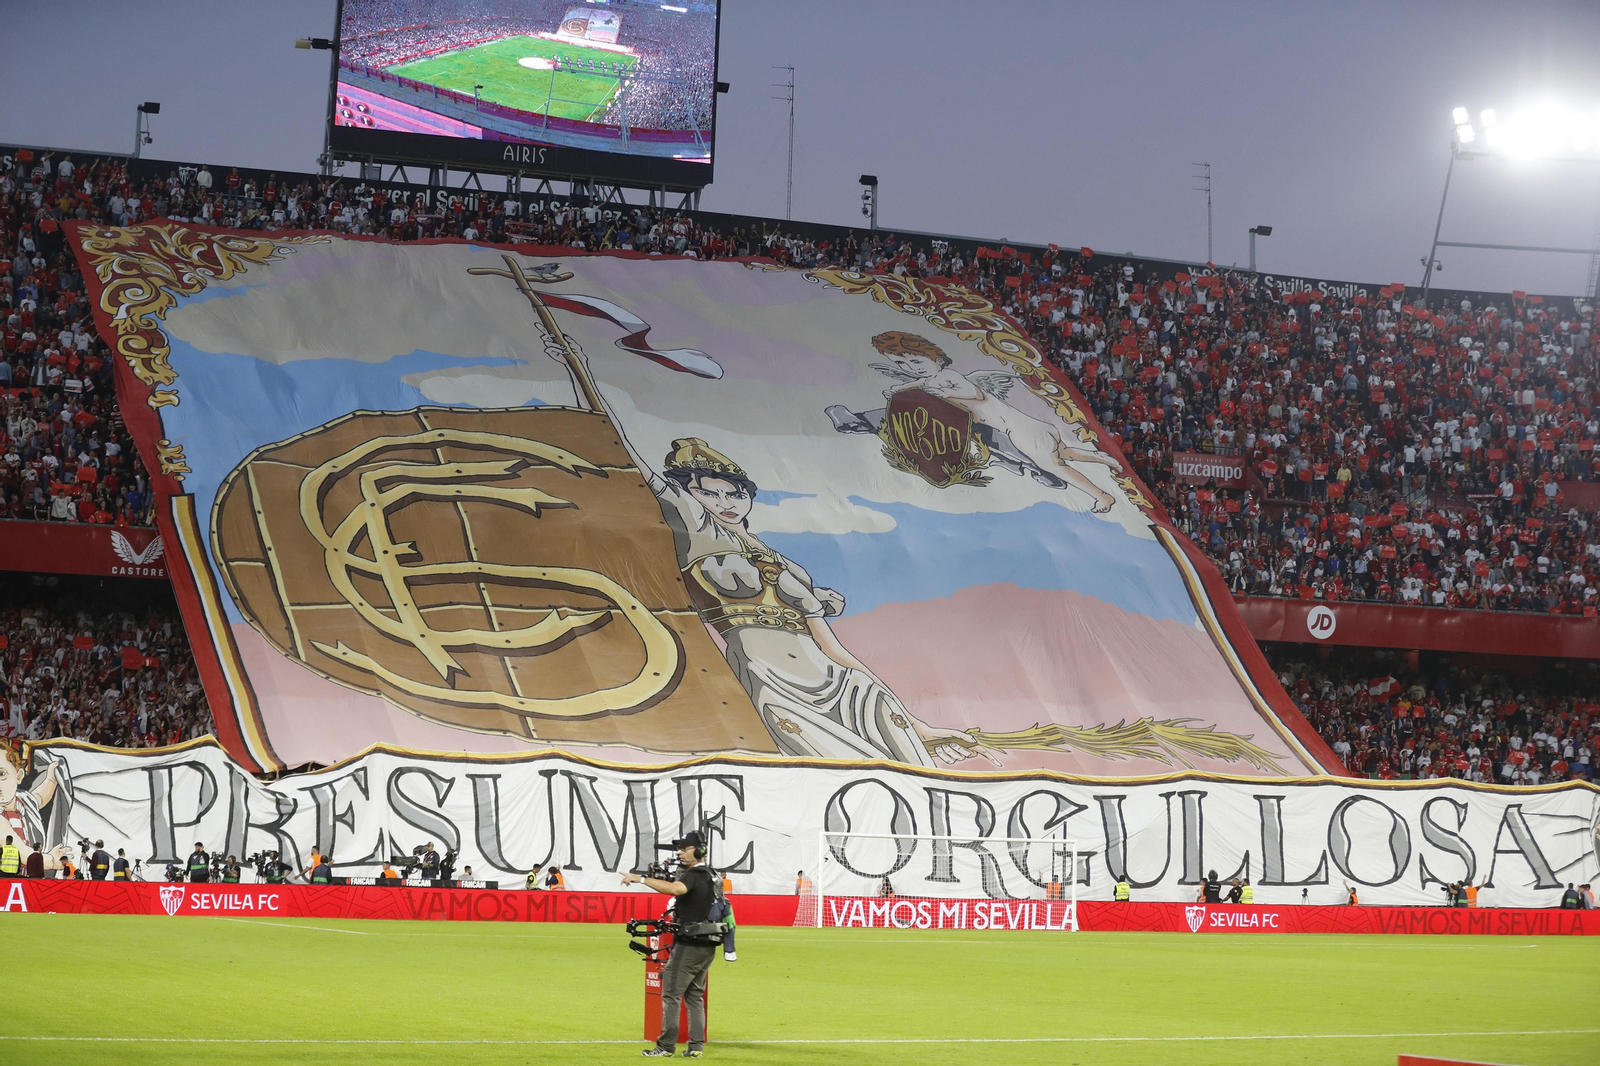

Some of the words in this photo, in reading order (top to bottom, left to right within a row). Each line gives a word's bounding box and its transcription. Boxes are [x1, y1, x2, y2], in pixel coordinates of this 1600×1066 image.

[503, 144, 547, 164] AIRIS
[1172, 462, 1243, 482] ruzcampo
[111, 566, 164, 577] CASTORE
[1310, 613, 1333, 631] JD
[141, 760, 755, 884] PRESUME
[824, 778, 1565, 900] ORGULLOSA
[190, 893, 254, 910] SEVILLA
[258, 894, 280, 911] FC
[406, 891, 518, 921] VAMOS
[526, 894, 558, 922] MI
[829, 899, 932, 928] VAMOS
[938, 902, 967, 929] MI
[974, 902, 1079, 931] SEVILLA
[1209, 912, 1259, 927] SEVILLA
[1262, 913, 1279, 928] FC
[1377, 909, 1462, 935] VAMOS
[1467, 911, 1491, 935] MI
[1497, 911, 1585, 936] SEVILLA
